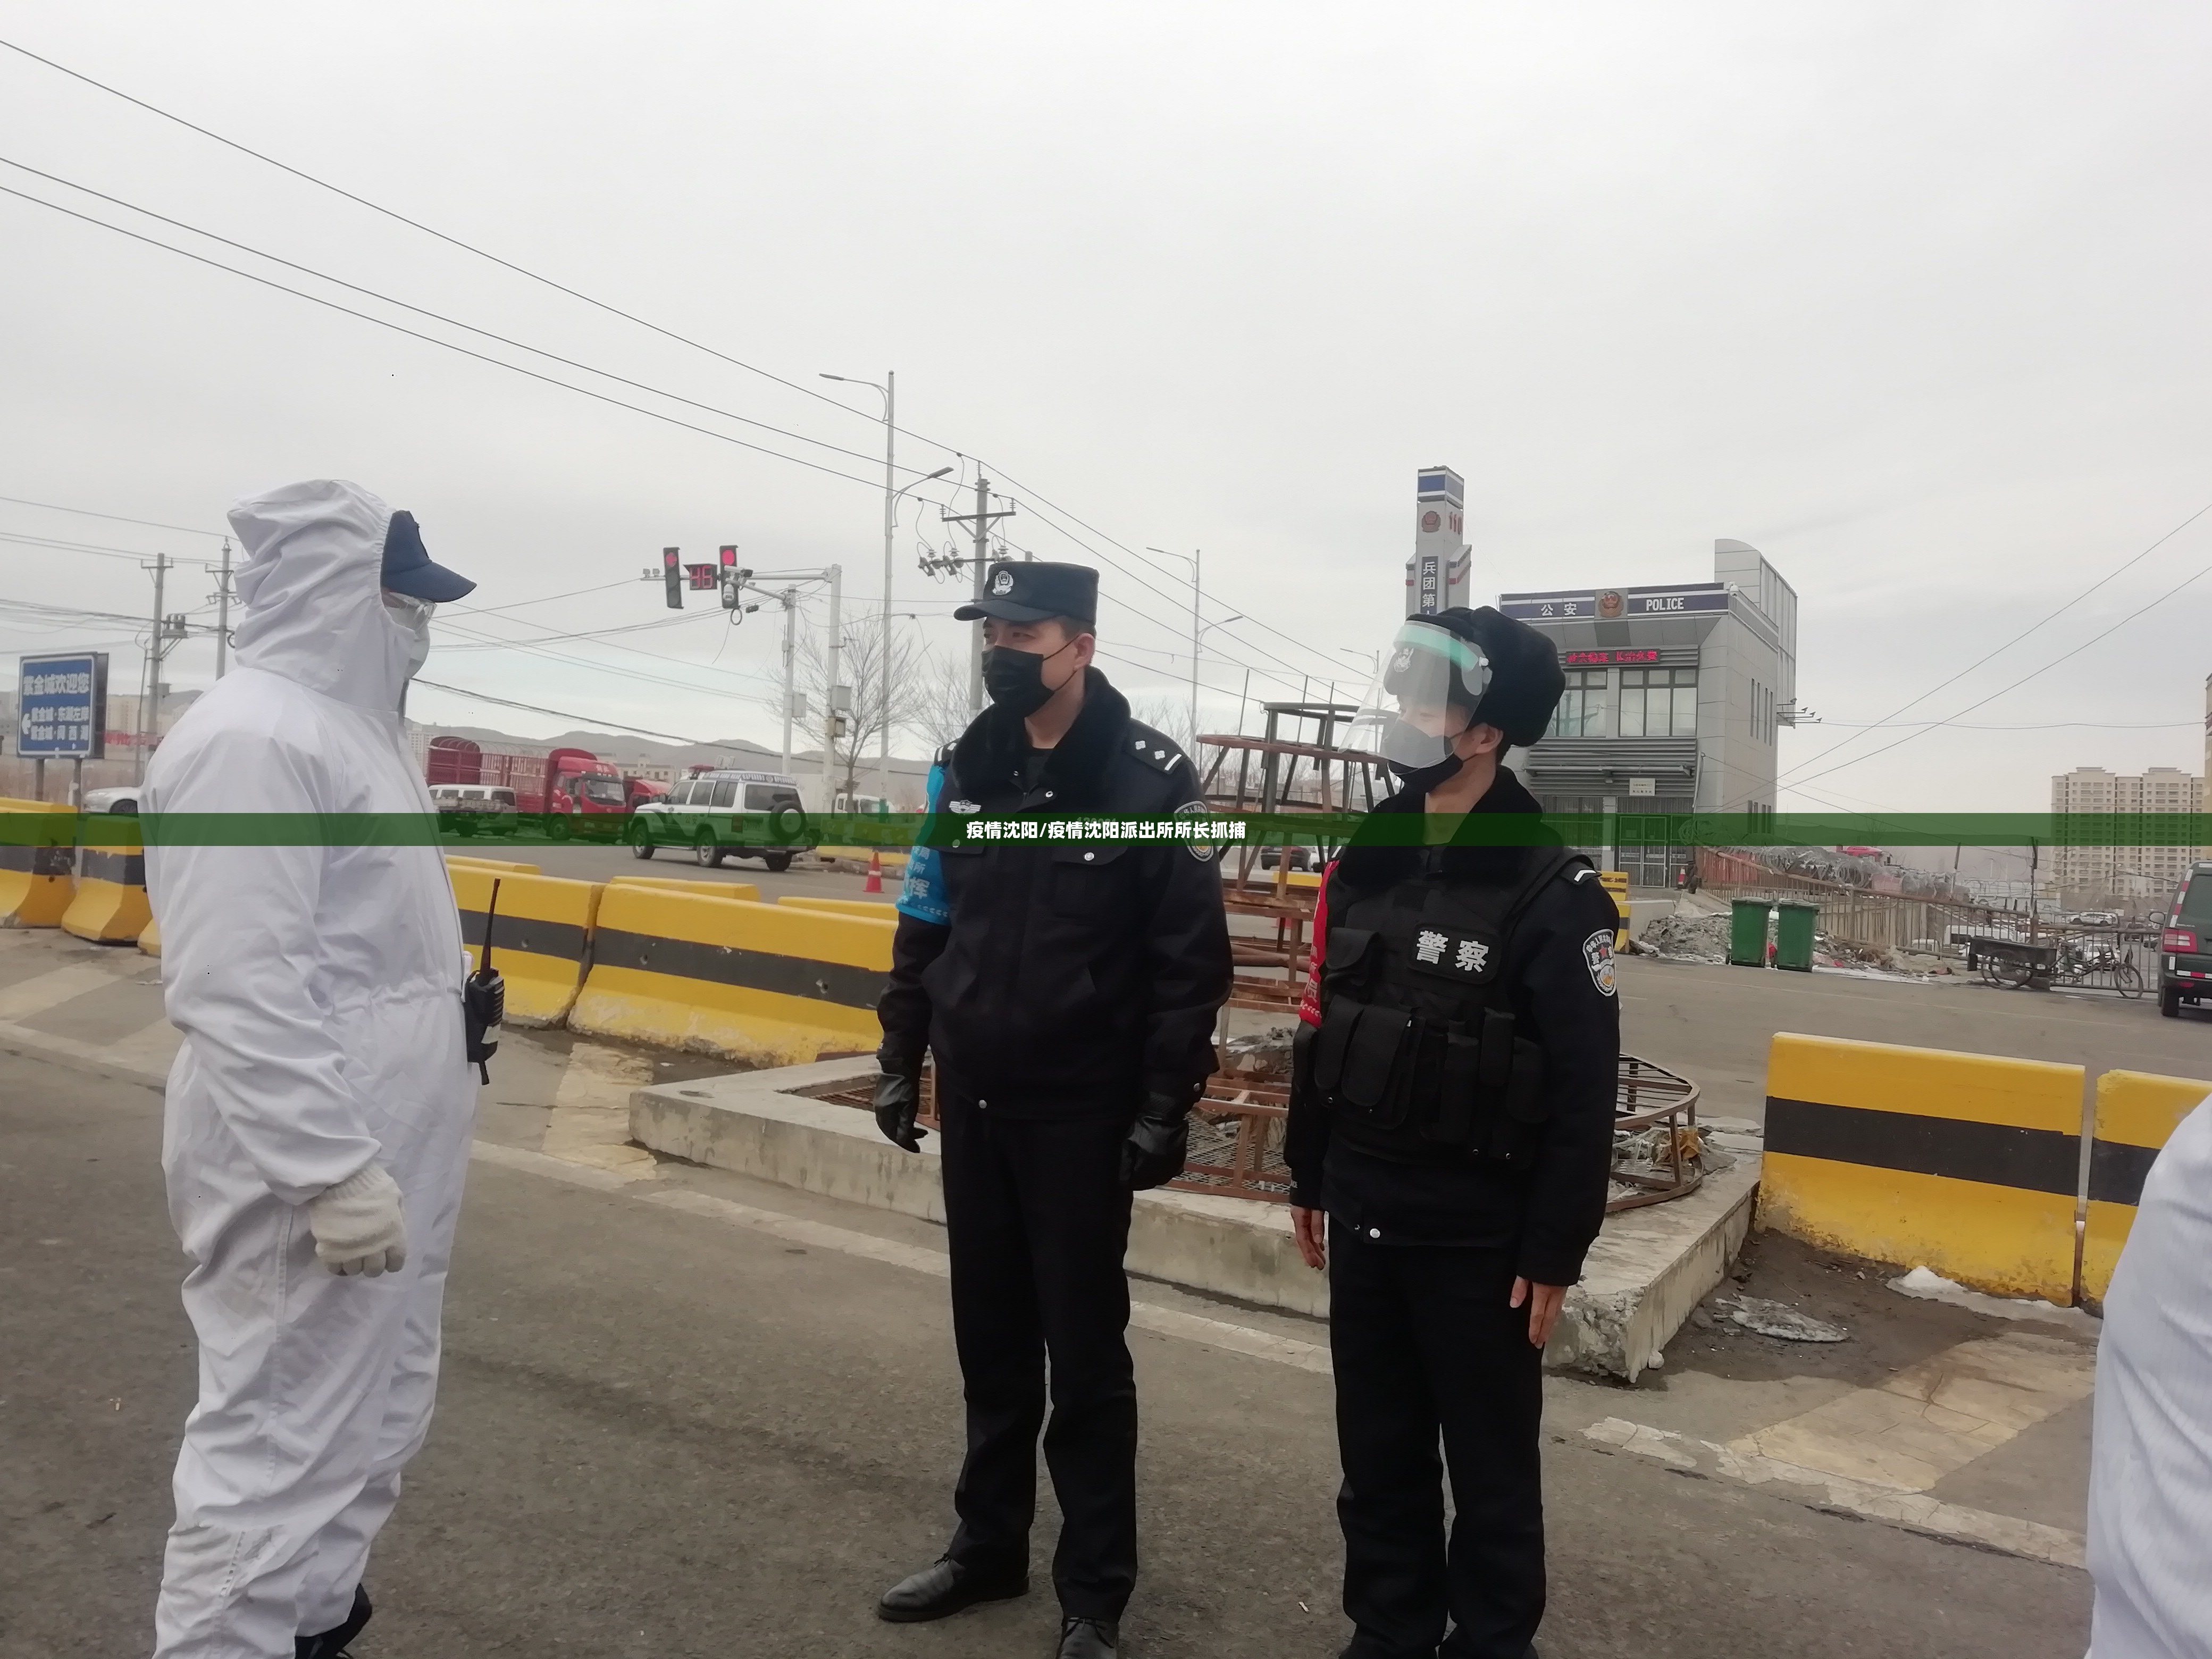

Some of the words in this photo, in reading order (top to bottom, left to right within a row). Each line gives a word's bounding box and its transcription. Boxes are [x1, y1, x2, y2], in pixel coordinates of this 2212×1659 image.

[1422, 561, 1436, 615] 兵团第
[1541, 604, 1577, 617] 公安
[1646, 597, 1685, 611] POLICE
[1415, 930, 1489, 973] 警察
